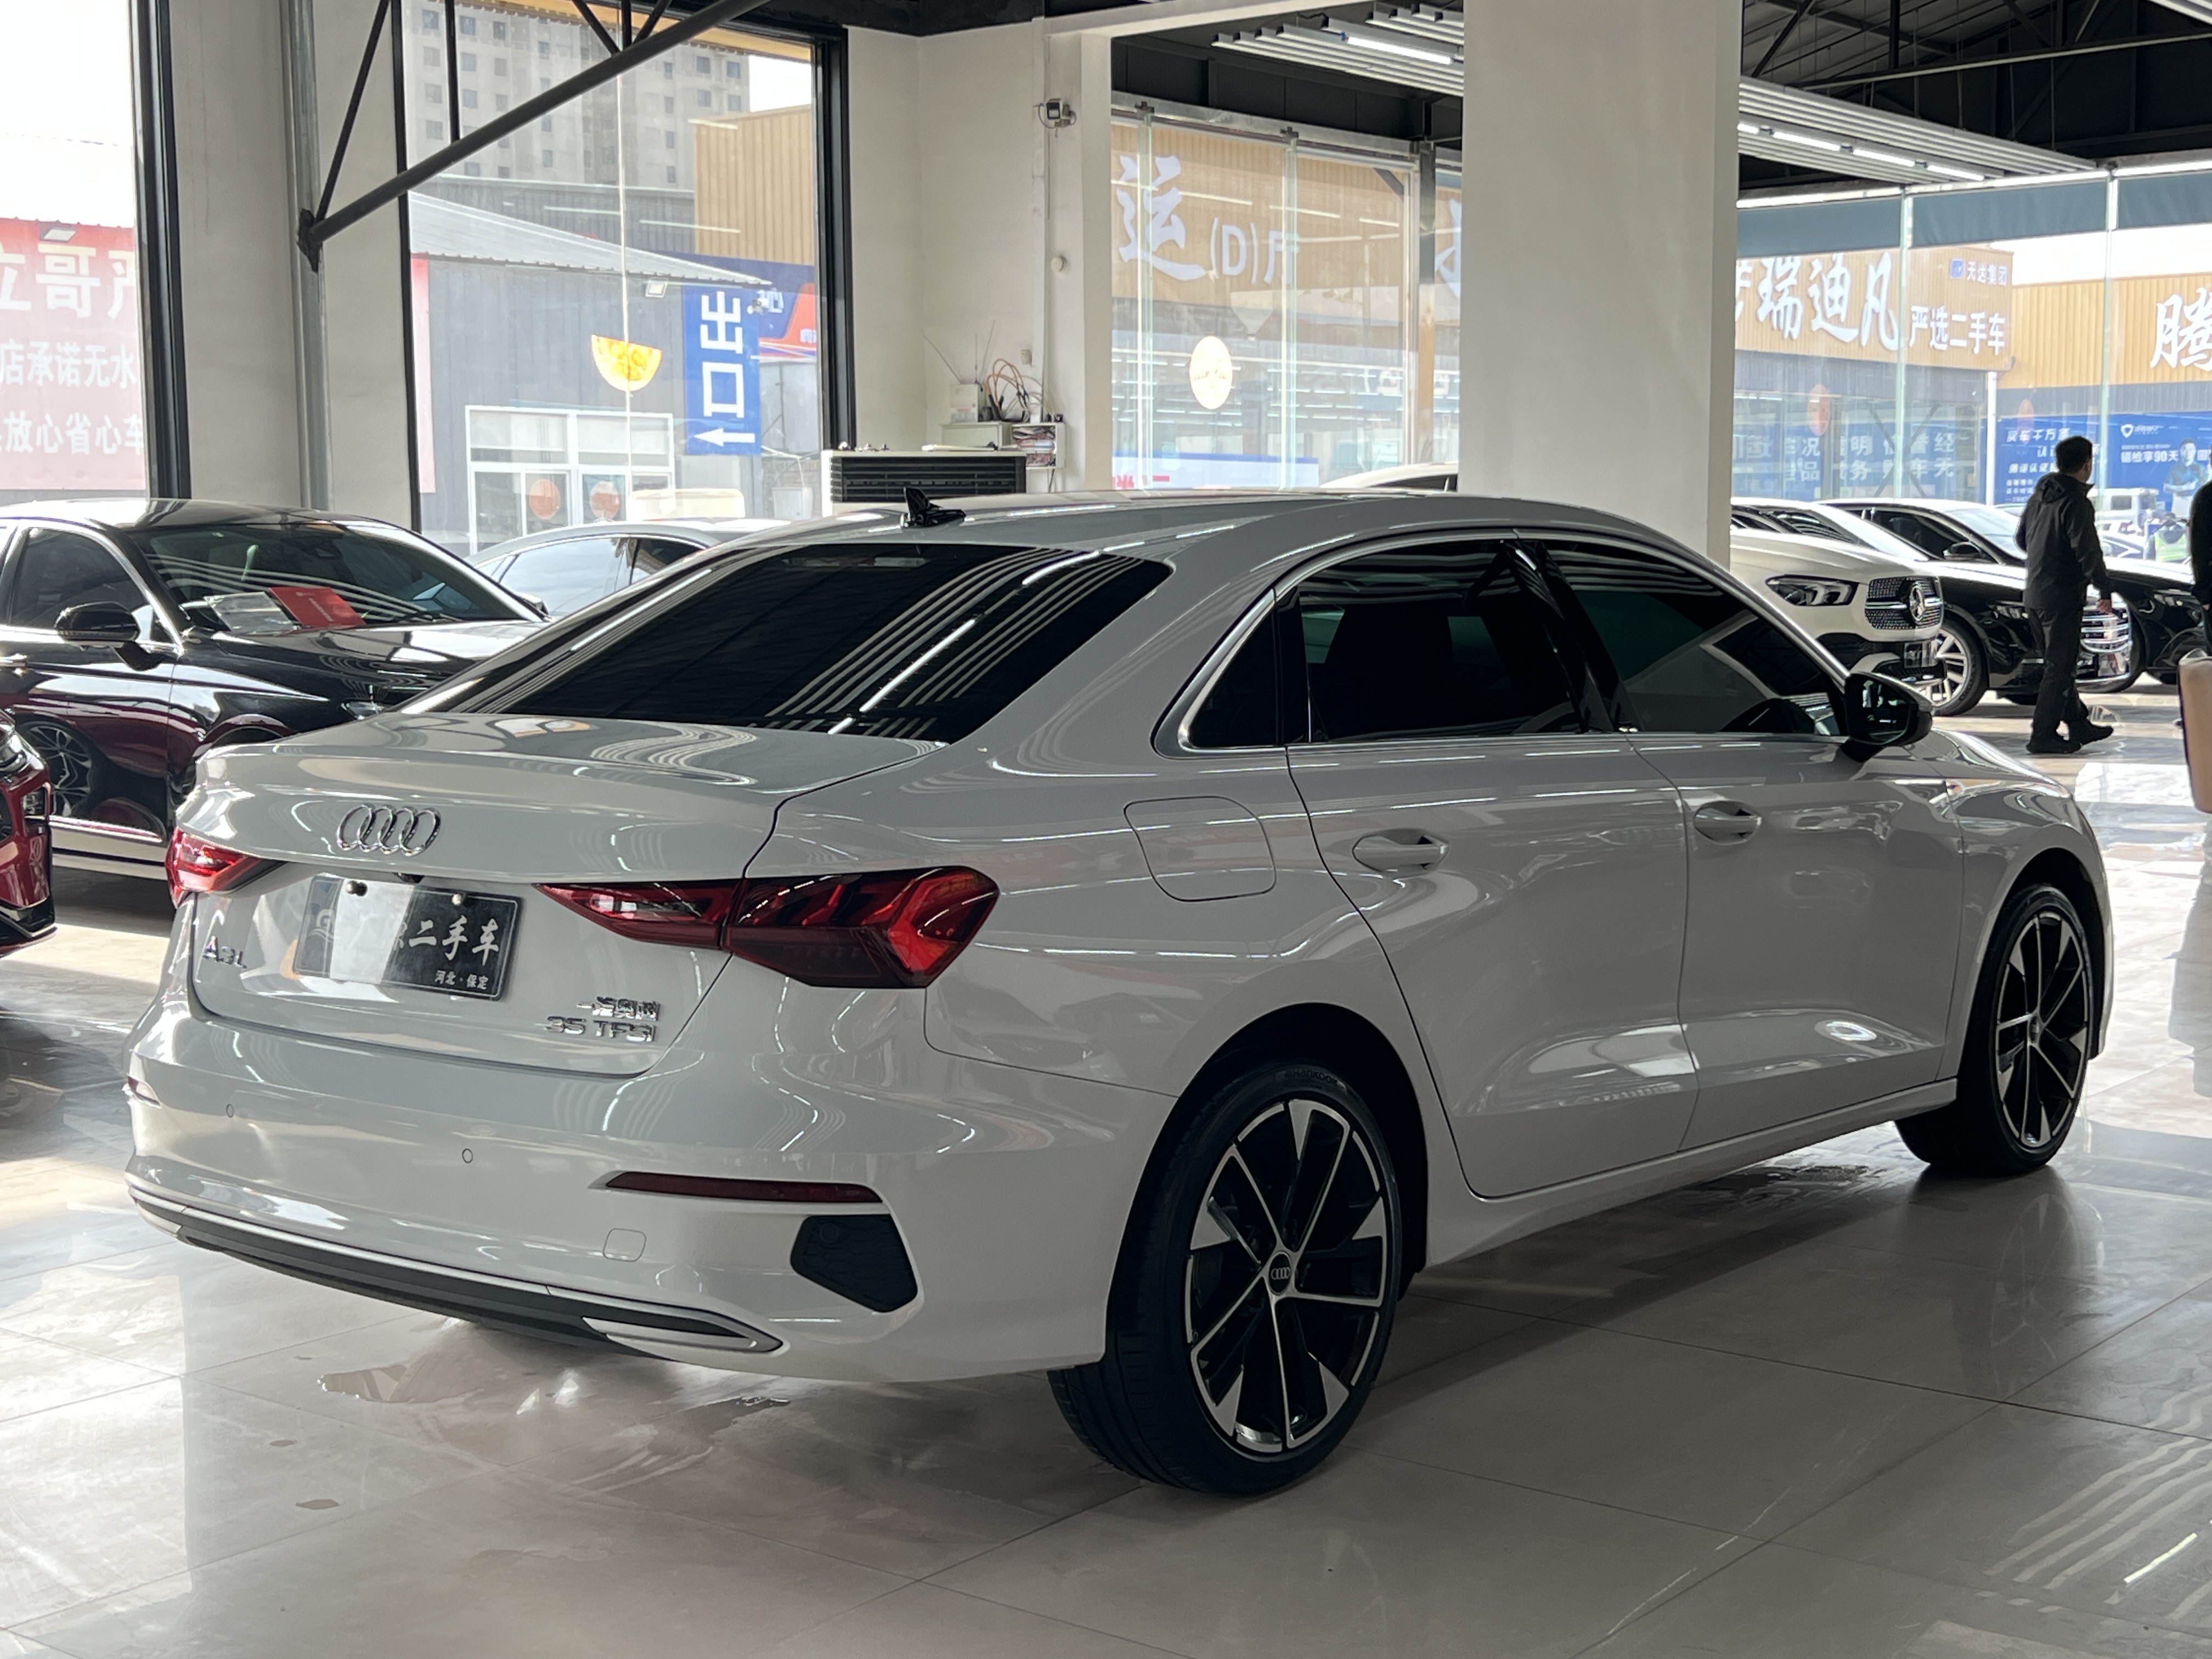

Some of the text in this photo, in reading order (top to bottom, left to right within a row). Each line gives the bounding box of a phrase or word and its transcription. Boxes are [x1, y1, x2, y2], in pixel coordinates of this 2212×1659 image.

[699, 291, 745, 418] 出口
[1909, 306, 2006, 356] 严选二手车
[0, 338, 138, 390] 店承诺无水
[0, 411, 144, 456] 放心省心车
[202, 935, 247, 969] A3L
[393, 915, 499, 966] 二手车
[434, 969, 489, 990] 河北·保定
[544, 1016, 657, 1042] 35 TFSI
